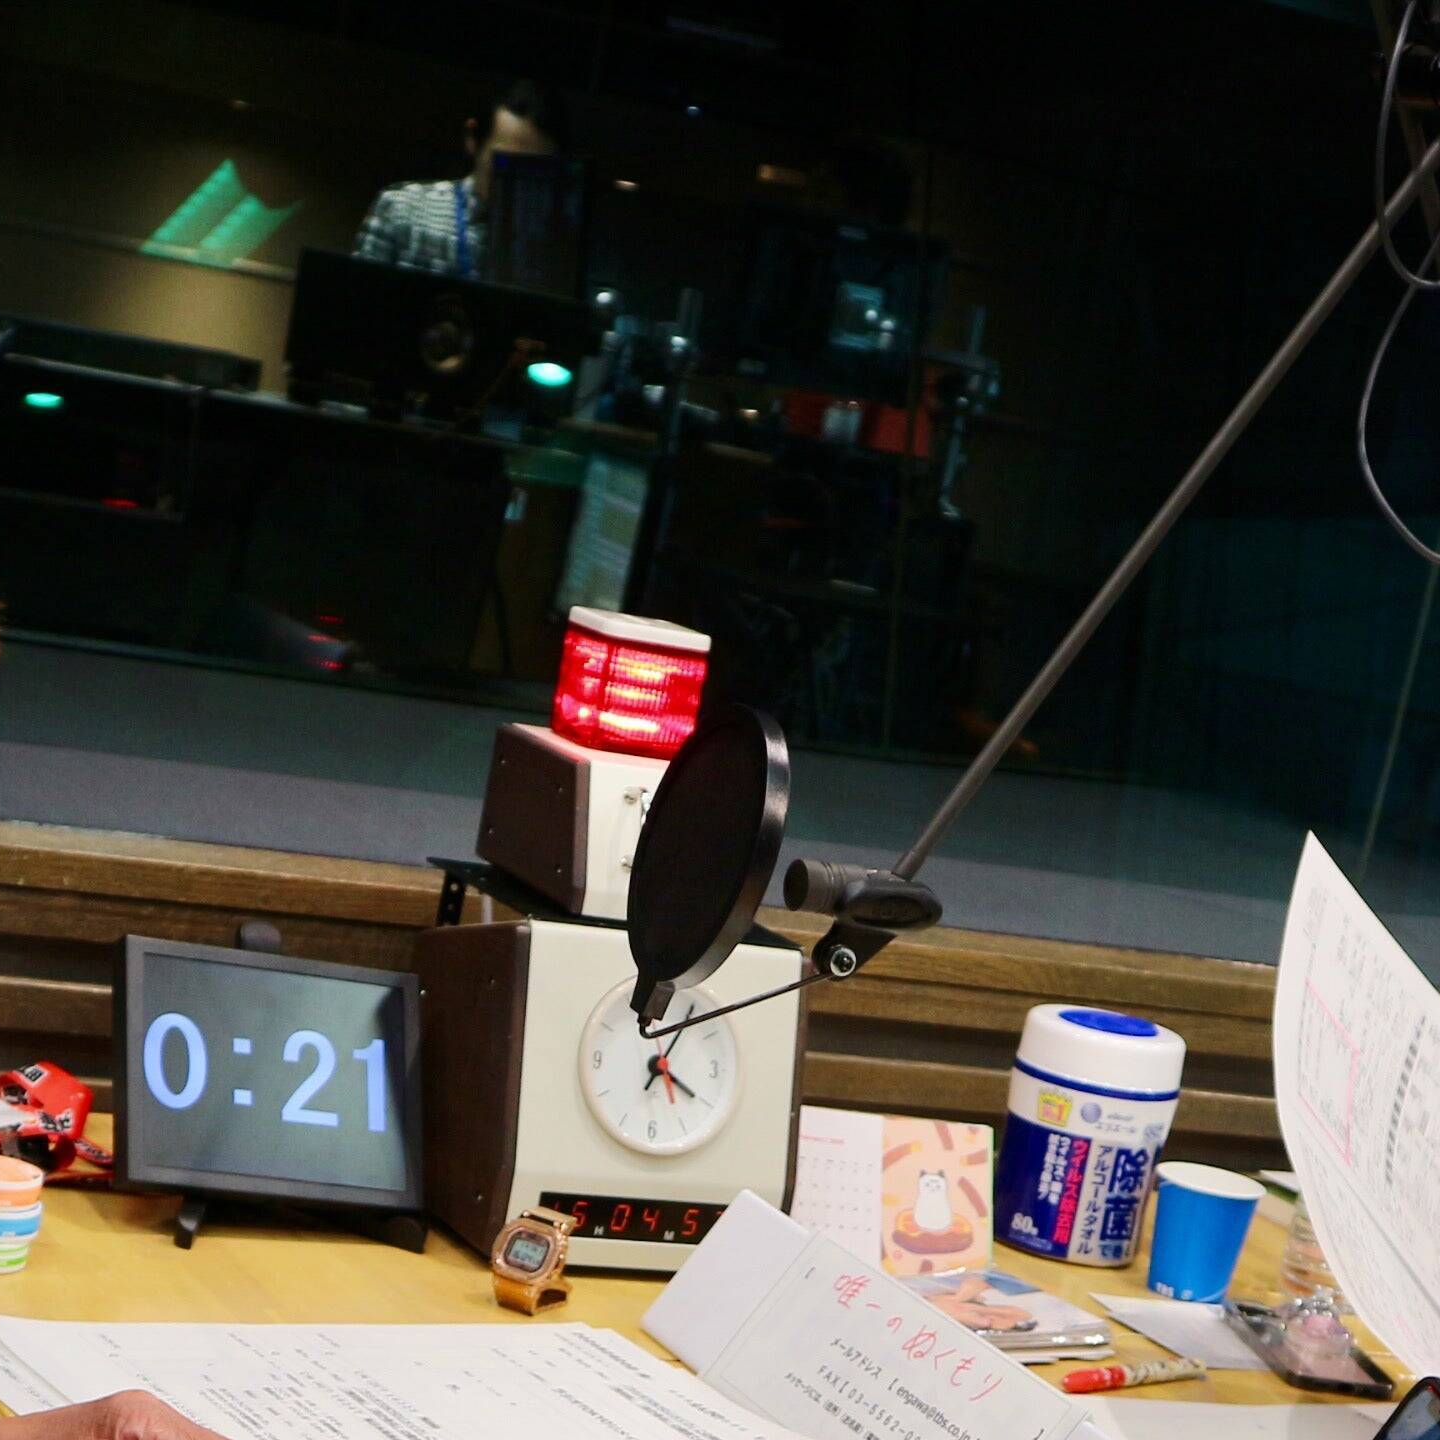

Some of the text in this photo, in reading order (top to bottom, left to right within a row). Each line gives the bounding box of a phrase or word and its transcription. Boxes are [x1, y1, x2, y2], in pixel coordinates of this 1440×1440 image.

[143, 1012, 387, 1133] 0:21
[592, 1050, 602, 1069] 9
[709, 1060, 719, 1078] 3
[647, 1120, 657, 1139] 6
[1076, 1144, 1113, 1255] アルコールタオル
[1099, 1148, 1150, 1241] 除菌
[610, 1204, 660, 1231] 04
[829, 1336, 884, 1380] メールアドレス
